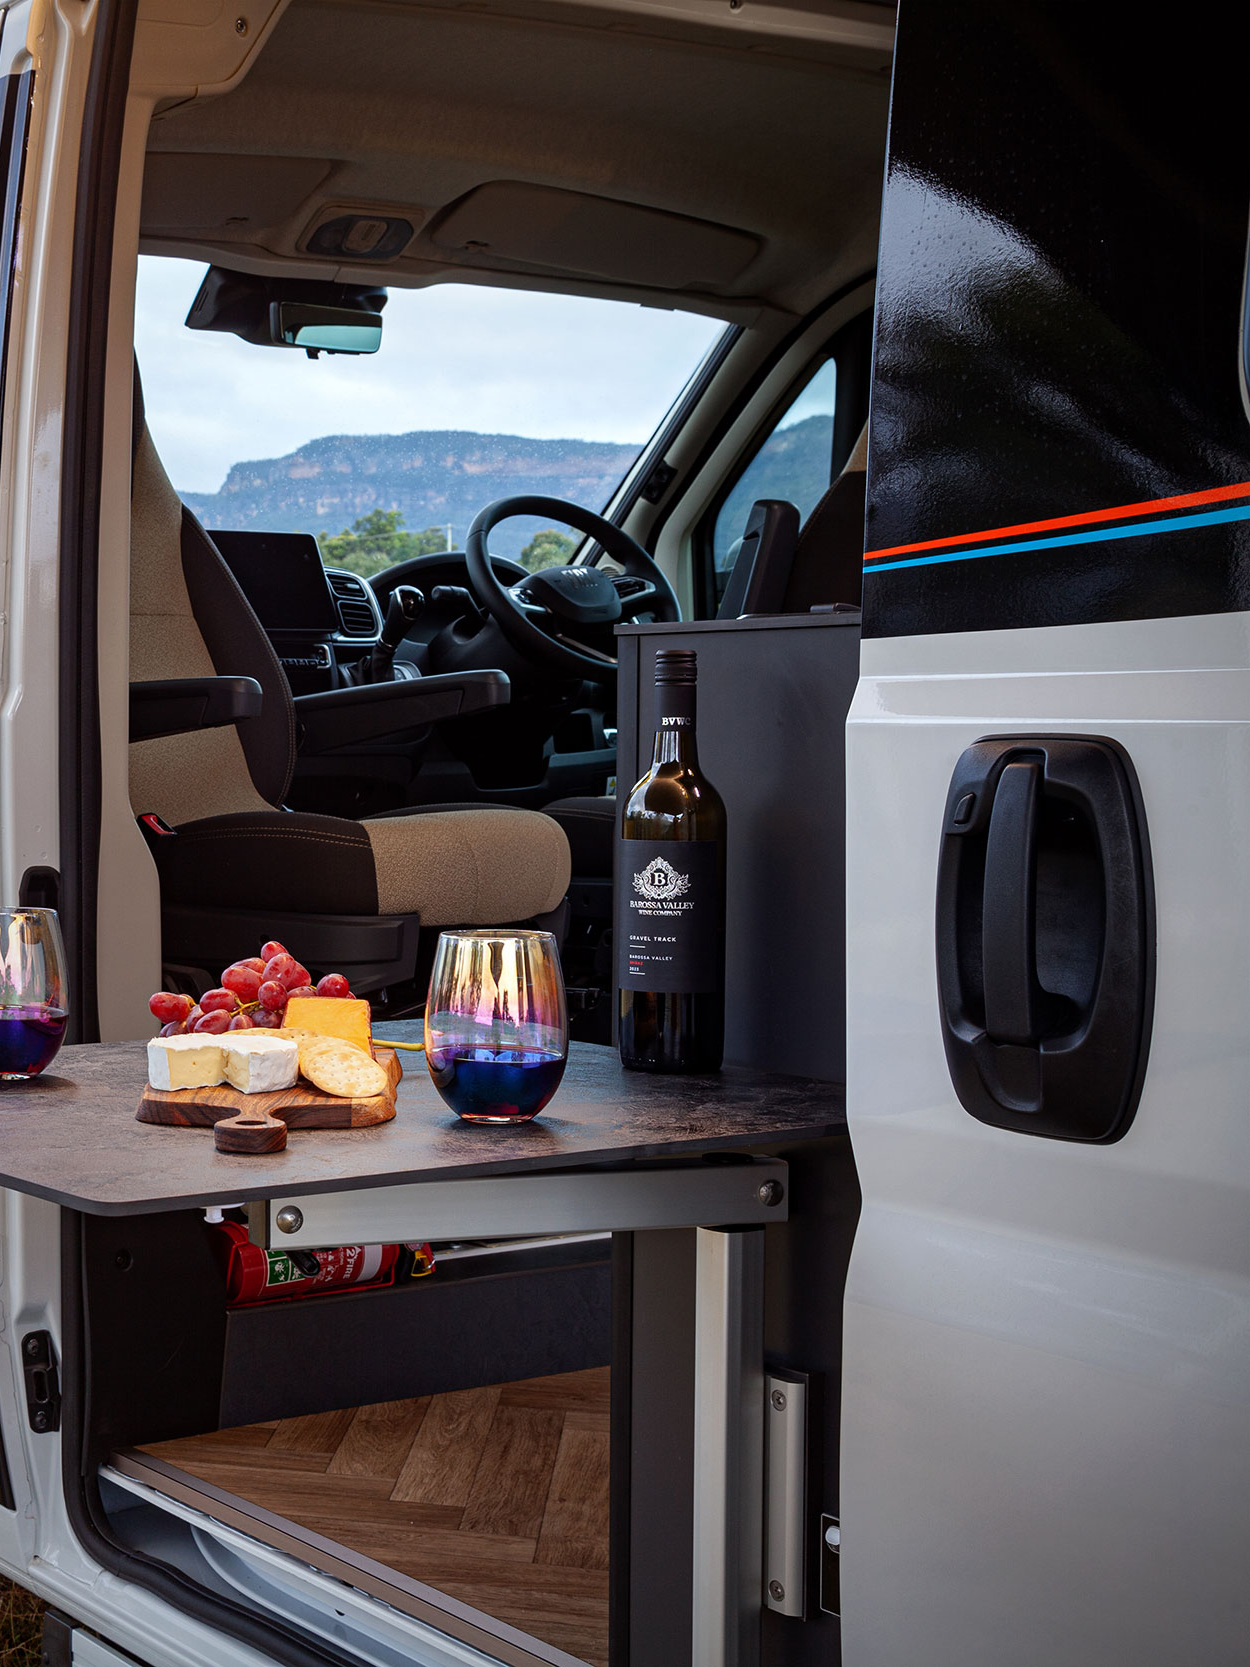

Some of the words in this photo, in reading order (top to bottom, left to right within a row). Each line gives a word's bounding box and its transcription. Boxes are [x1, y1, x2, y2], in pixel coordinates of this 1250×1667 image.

[661, 717, 691, 726] BVWC
[653, 872, 666, 886] B
[629, 900, 662, 909] BAROSSA
[663, 902, 695, 910] VALLEY
[629, 934, 652, 942] GRAVEL
[342, 1258, 354, 1279] FIRE
